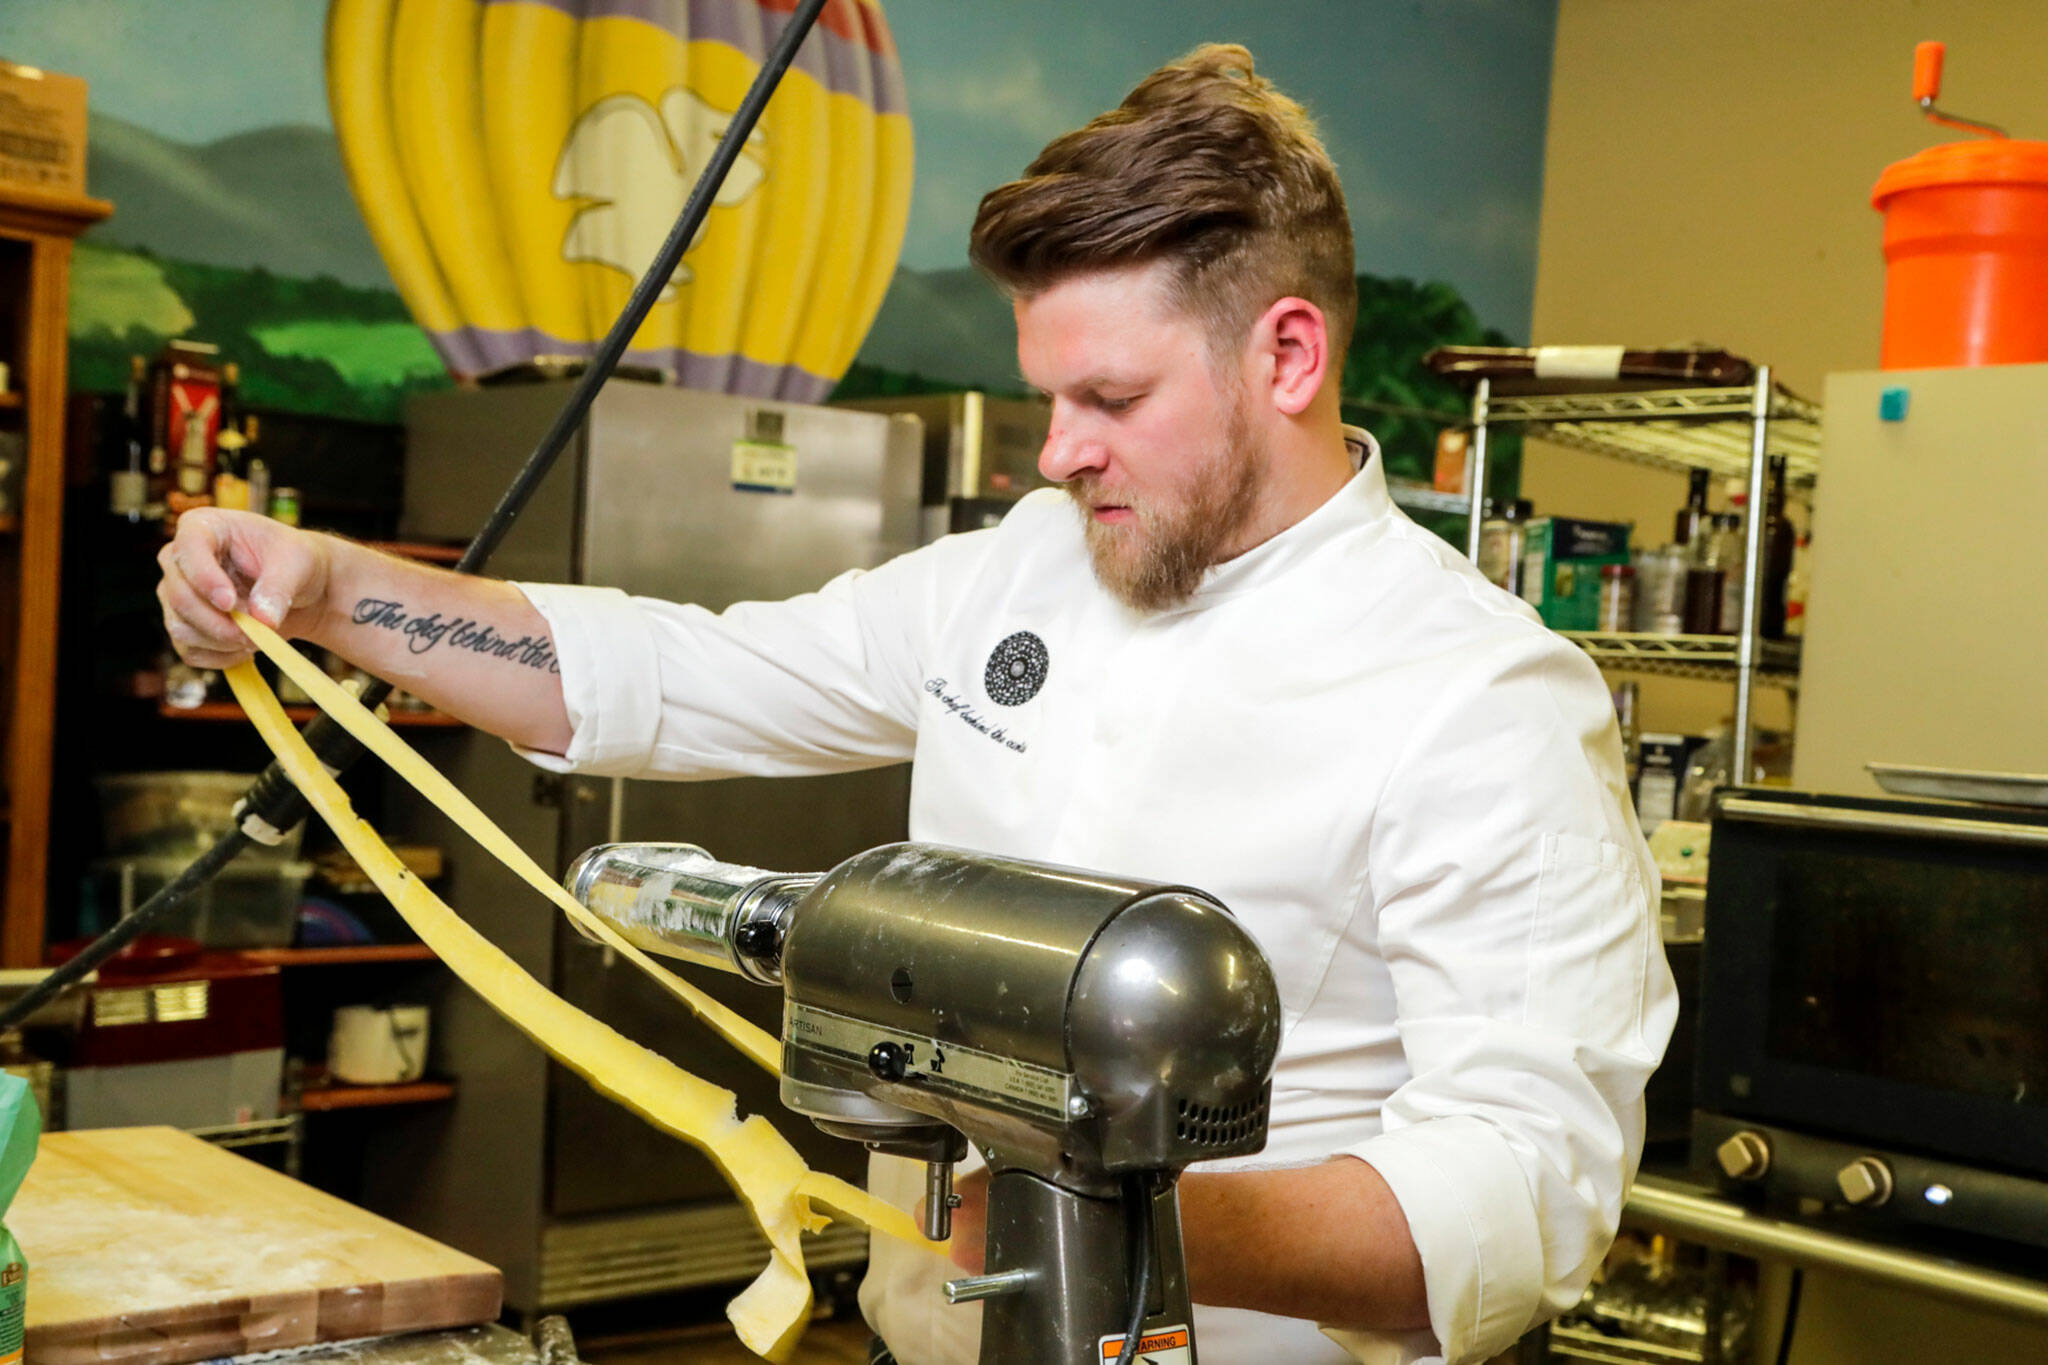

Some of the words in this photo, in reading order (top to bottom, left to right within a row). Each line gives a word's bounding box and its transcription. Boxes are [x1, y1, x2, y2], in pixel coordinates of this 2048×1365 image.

[352, 598, 406, 631] The
[403, 613, 464, 655] chef
[448, 618, 530, 662] behind
[518, 635, 552, 671] the
[1140, 1336, 1176, 1351] ARNING
